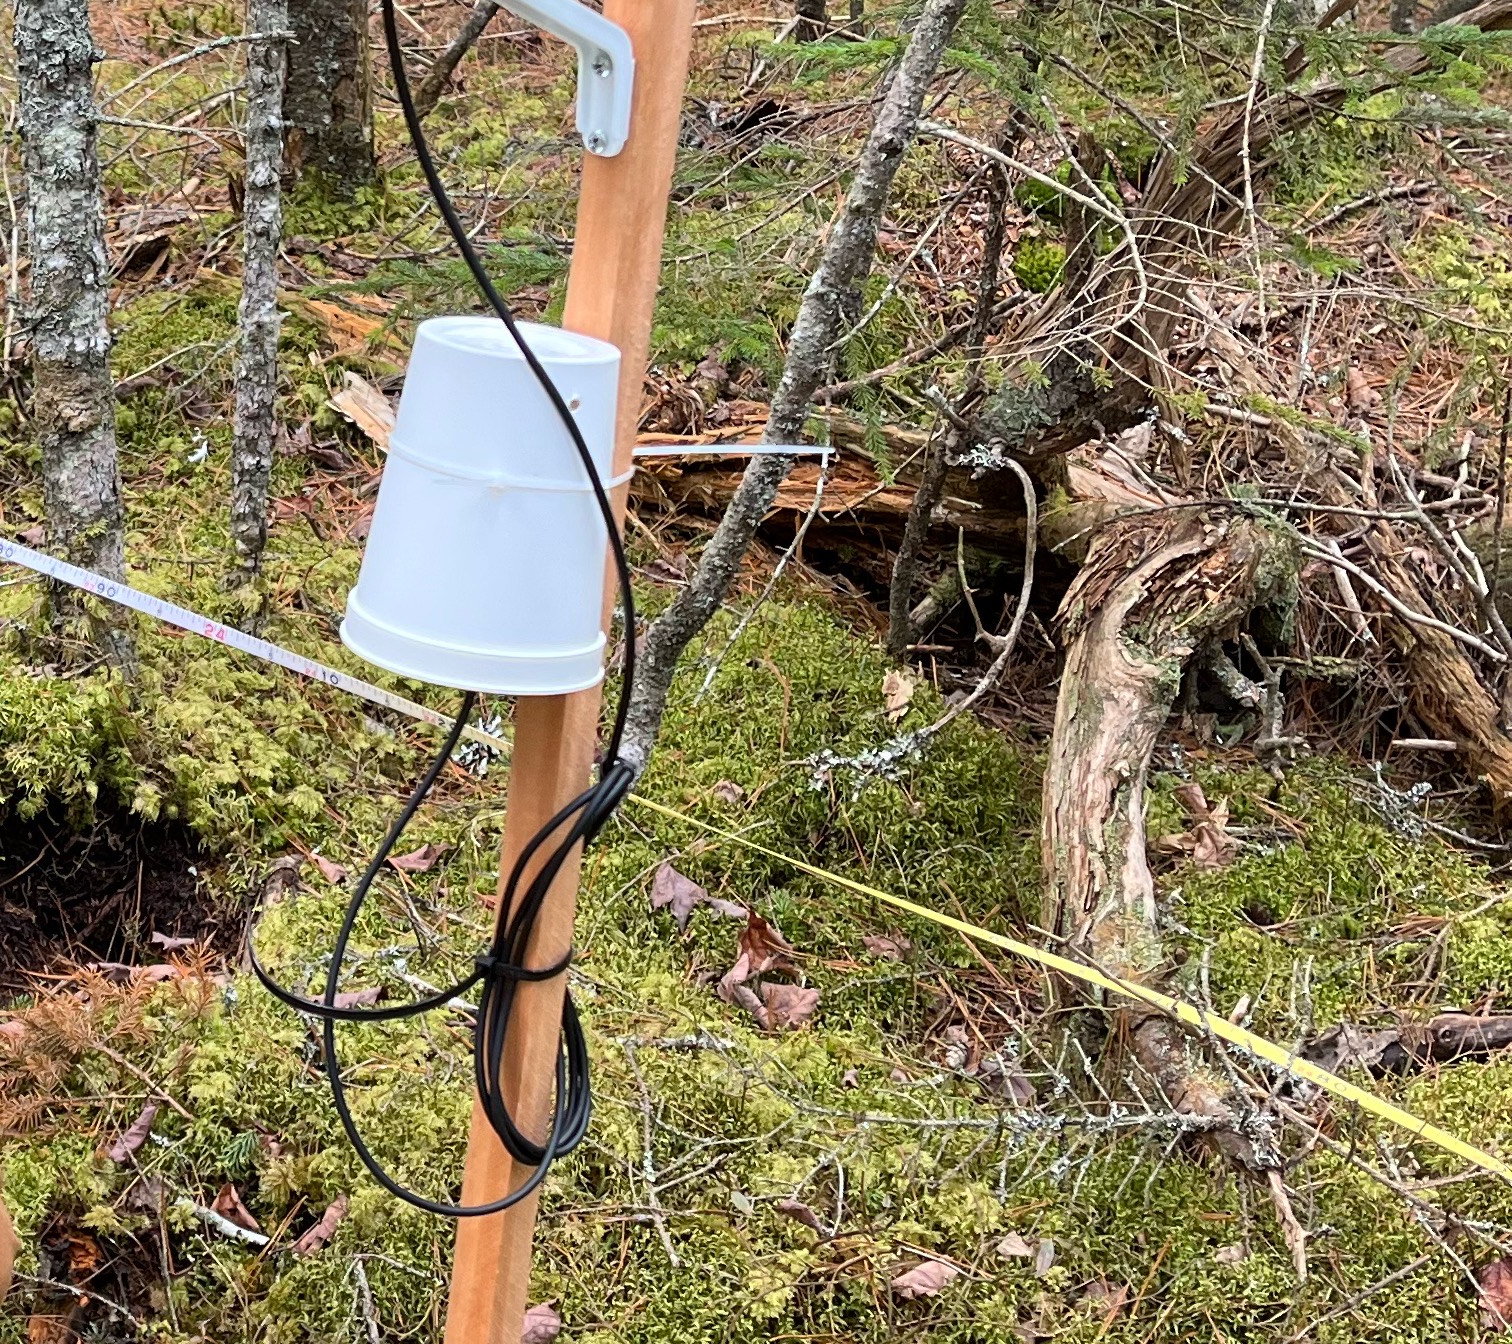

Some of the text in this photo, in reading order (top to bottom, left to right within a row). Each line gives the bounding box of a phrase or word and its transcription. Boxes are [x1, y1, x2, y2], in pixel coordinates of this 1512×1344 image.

[97, 583, 116, 597] 90
[205, 624, 225, 640] 24
[323, 671, 338, 684] 10
